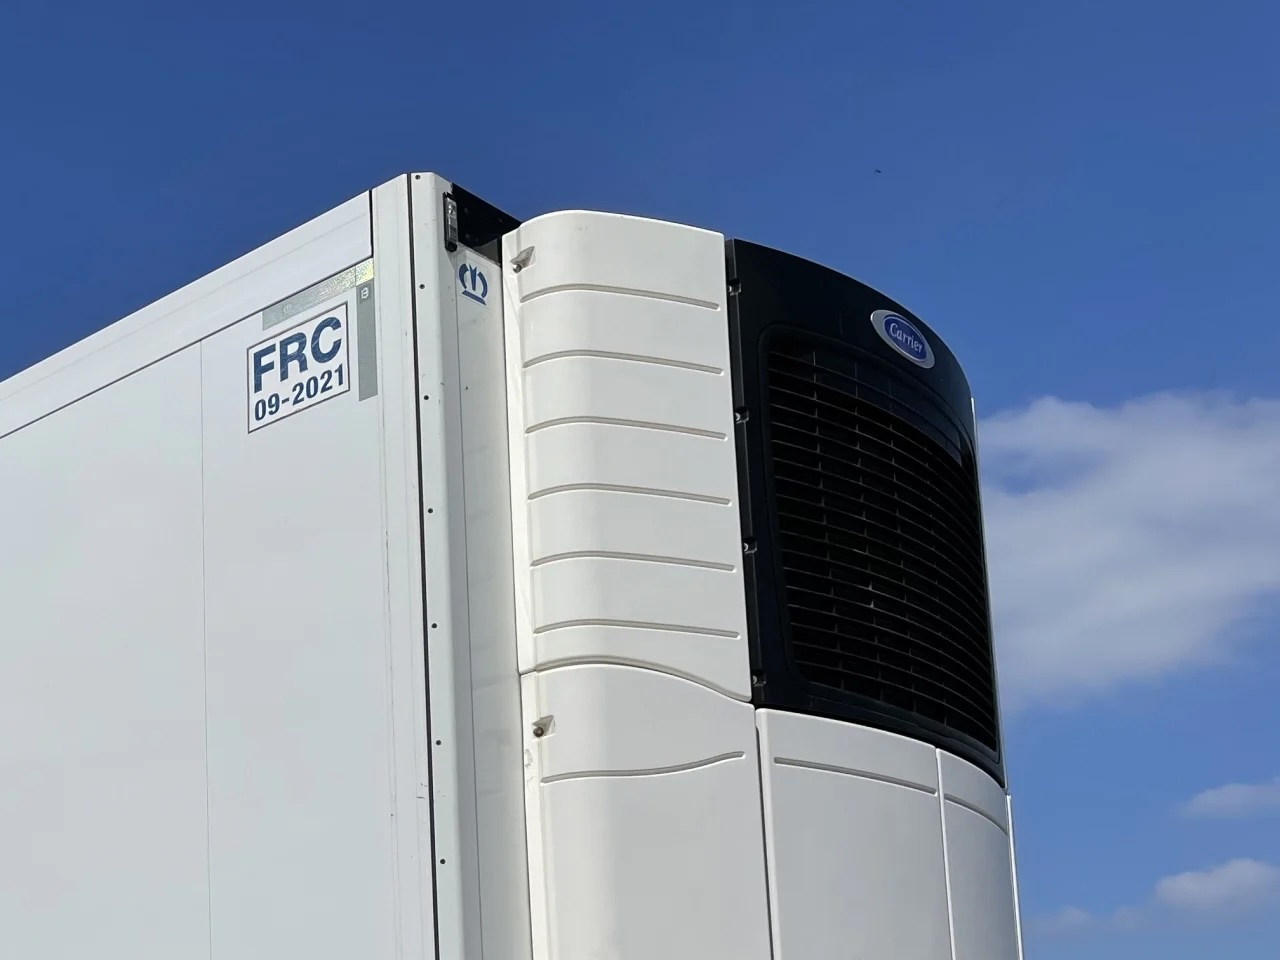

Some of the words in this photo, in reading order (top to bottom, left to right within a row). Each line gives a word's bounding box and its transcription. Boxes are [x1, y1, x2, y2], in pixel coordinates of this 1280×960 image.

[253, 316, 342, 394] FRC
[890, 323, 922, 353] Carrier
[254, 363, 343, 421] 09-2021
